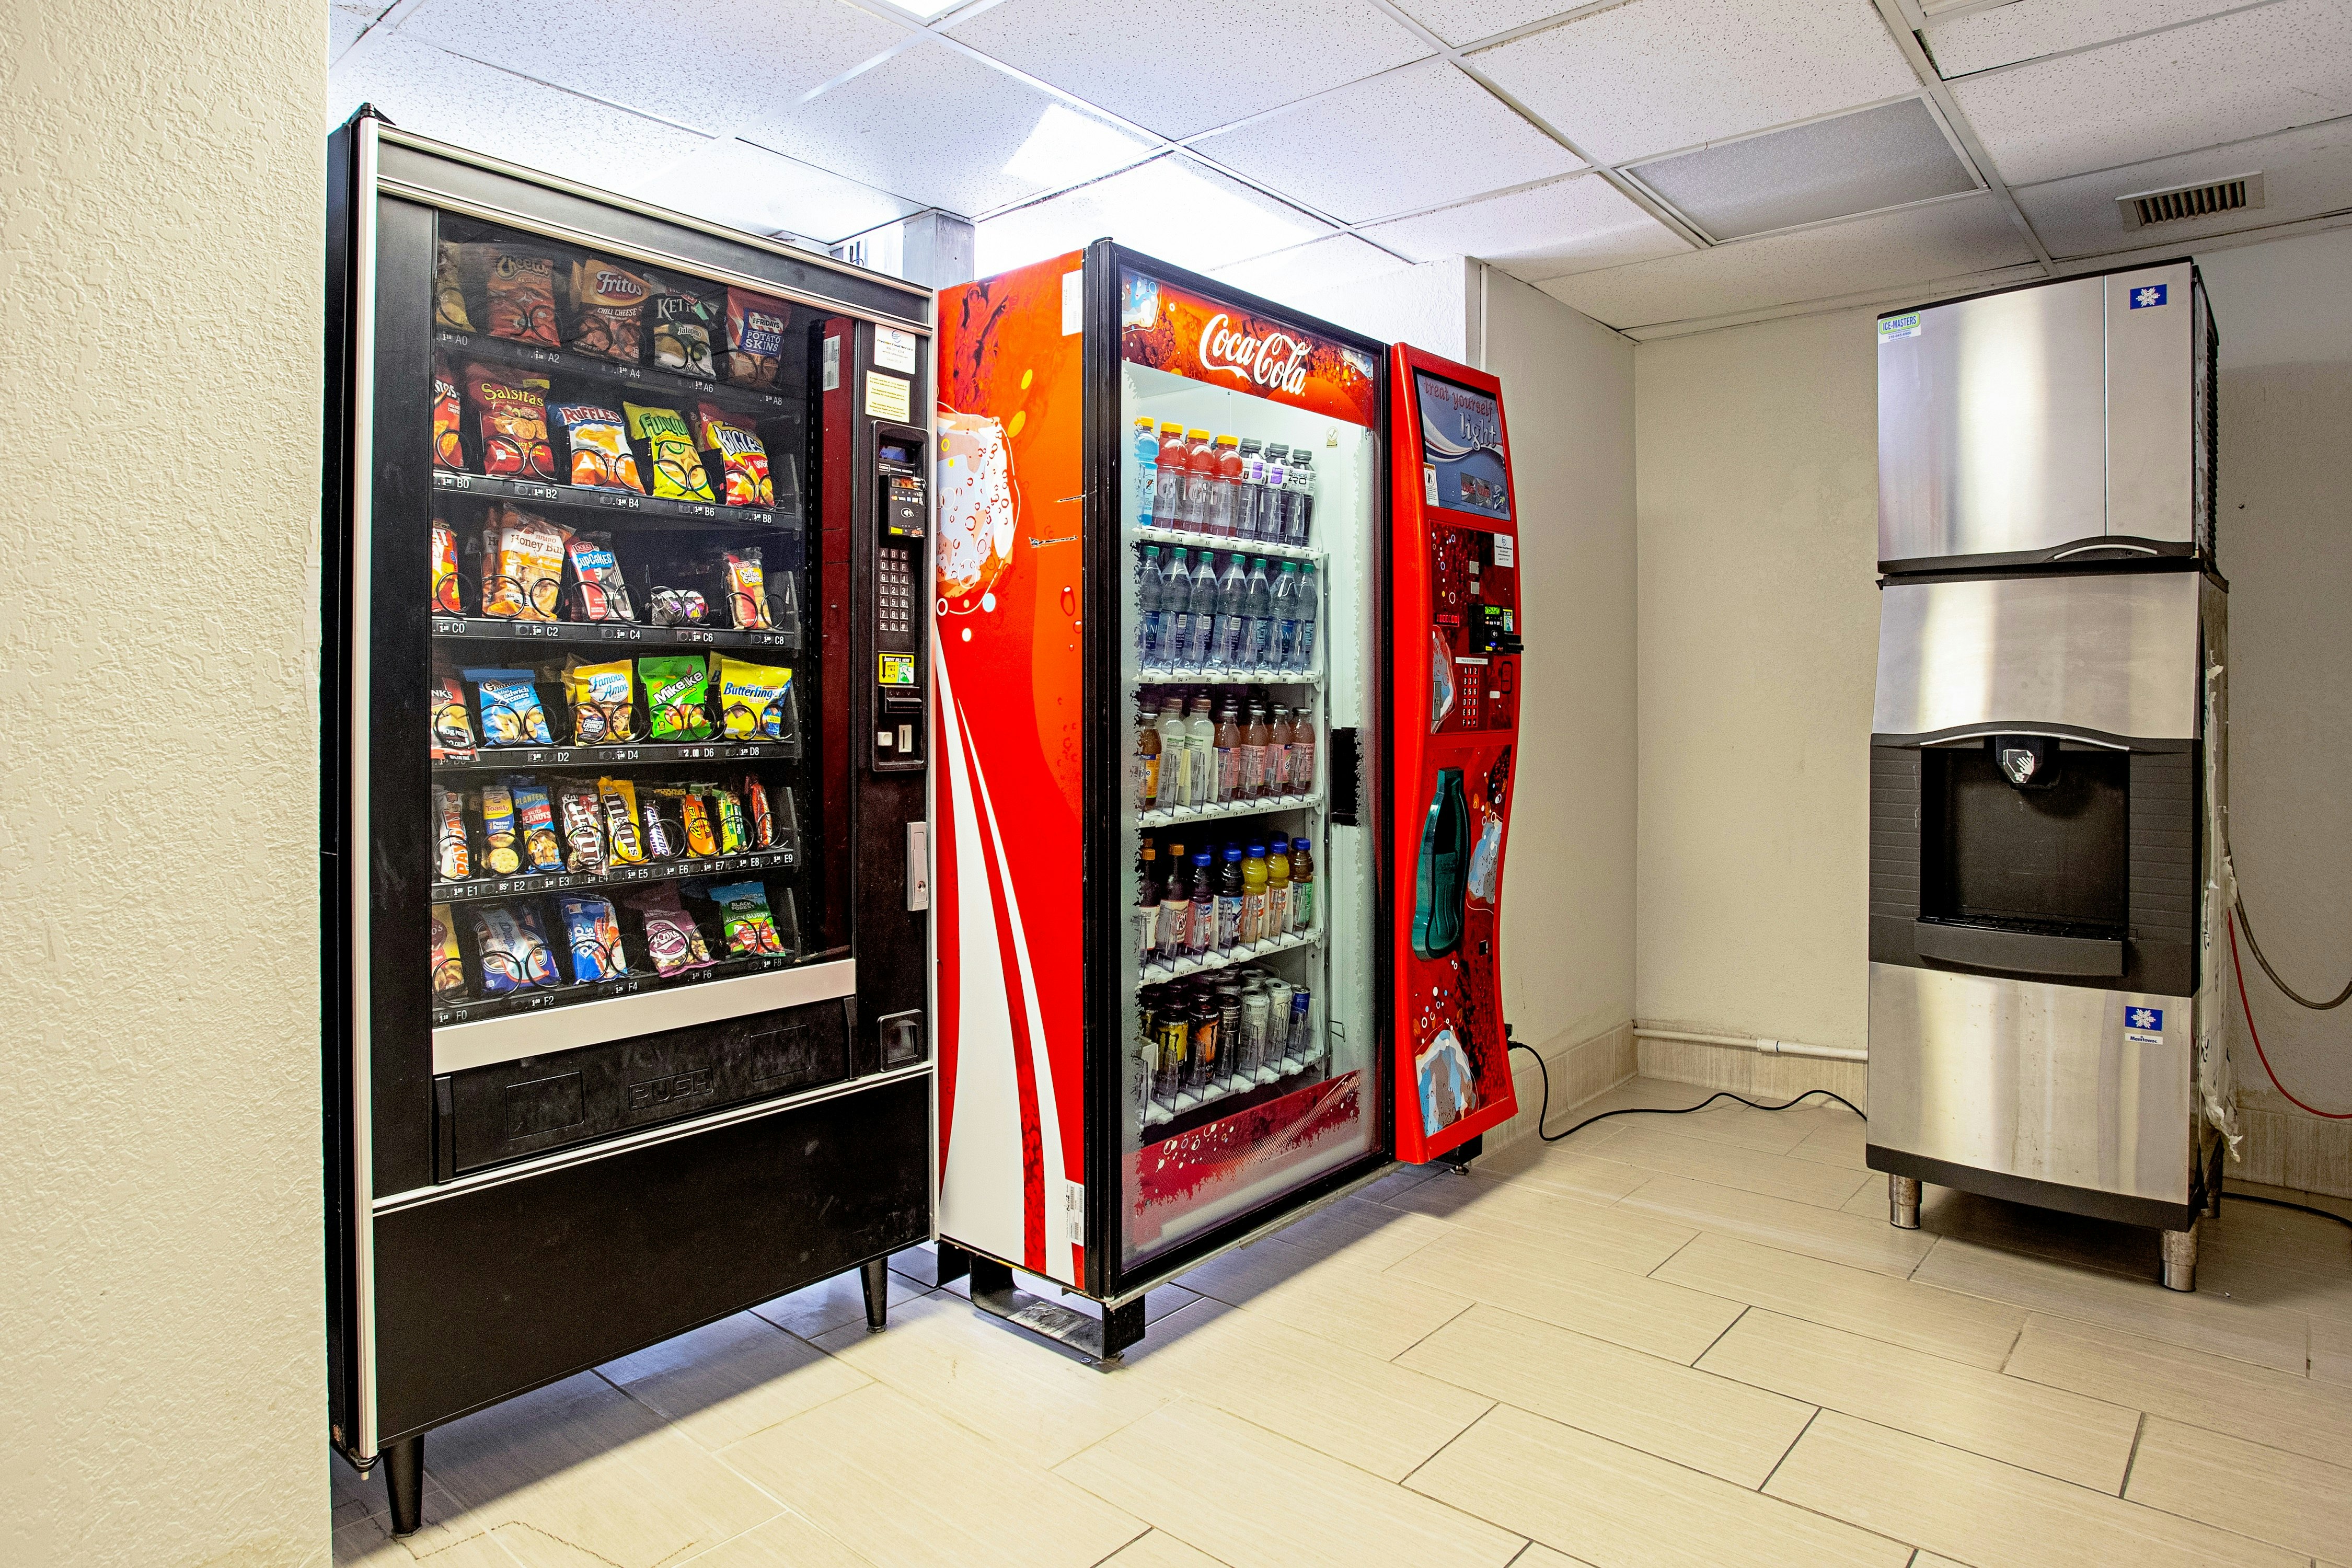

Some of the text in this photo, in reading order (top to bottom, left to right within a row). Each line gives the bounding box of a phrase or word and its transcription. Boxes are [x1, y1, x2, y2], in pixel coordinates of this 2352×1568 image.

[596, 271, 642, 295] Fritos
[615, 308, 637, 316] CHEESE
[756, 318, 780, 328] FRIDAYS
[1883, 315, 1916, 331] ICE-MASTERS
[455, 335, 468, 345] A0
[747, 330, 781, 343] POTATO
[745, 339, 779, 352] SKINS
[548, 353, 559, 363] A2
[1199, 314, 1312, 396] Coca-Cola
[630, 370, 640, 378] A4
[704, 384, 713, 392] A6
[481, 383, 544, 407] Salsitas
[1423, 378, 1492, 422] treat yourself
[773, 397, 782, 406] A8
[560, 407, 622, 424] RUFFLES
[1460, 412, 1496, 451] light
[713, 425, 765, 456] BUGLES
[457, 479, 469, 488] B0
[546, 488, 557, 499] B2
[629, 499, 639, 507] B4
[705, 507, 714, 516] B6
[763, 513, 772, 523] B8
[510, 534, 564, 555] Honey Bun
[740, 569, 759, 579] Coffee
[742, 574, 763, 584] Cakes
[452, 623, 465, 633] C0
[547, 627, 558, 636] C2
[630, 630, 640, 639] C4
[703, 633, 713, 642] C6
[775, 636, 783, 644] C8
[589, 673, 626, 694] Famous
[653, 681, 686, 705] Mike
[684, 672, 704, 686] Ike
[599, 683, 628, 701] Amos
[628, 751, 638, 759] D4
[704, 748, 714, 757] D6
[750, 747, 759, 756] D8
[558, 752, 569, 762] D2
[515, 792, 547, 806] PLANTERS
[486, 804, 510, 812] Toasty
[523, 812, 551, 823] PEANUTS
[751, 858, 759, 866] E8
[784, 854, 793, 863] E9
[679, 865, 688, 874] E6
[716, 861, 724, 870] E7
[639, 869, 648, 878] E5
[514, 882, 525, 891] E2
[559, 877, 570, 886] E3
[467, 886, 478, 895] E1
[774, 958, 781, 966] F8
[703, 970, 712, 979] F6
[629, 982, 638, 991] F4
[544, 996, 554, 1006] F2
[456, 1010, 467, 1020] F0
[631, 1069, 712, 1109] PUSH
